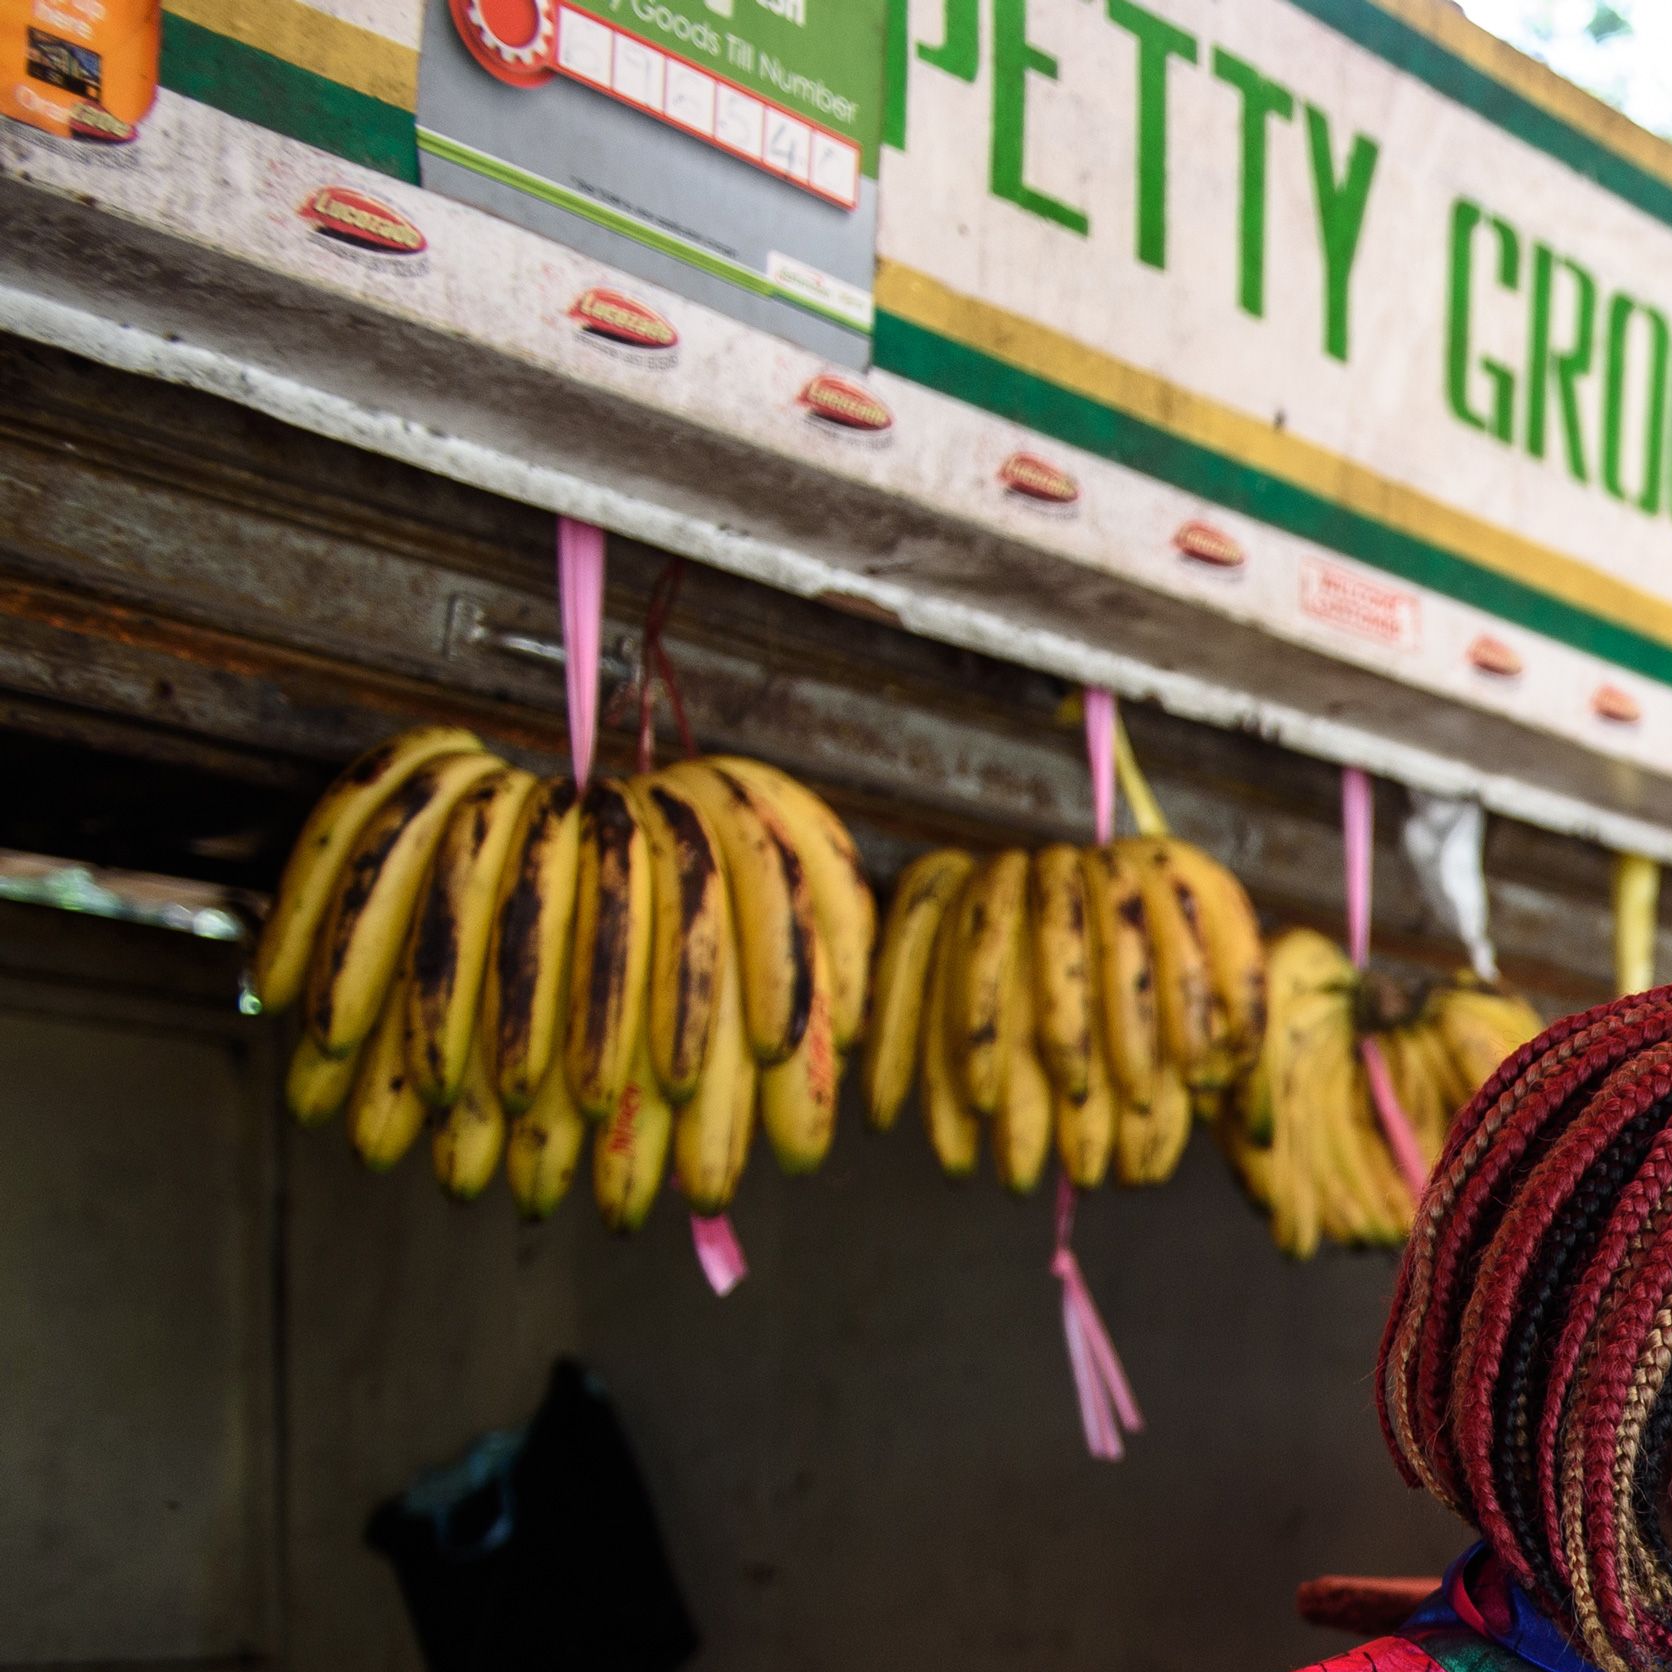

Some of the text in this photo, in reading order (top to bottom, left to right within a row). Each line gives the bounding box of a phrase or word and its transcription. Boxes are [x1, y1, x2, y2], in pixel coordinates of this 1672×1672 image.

[632, 0, 721, 56] Goods
[725, 31, 756, 72] Till
[758, 55, 860, 125] Number
[881, 0, 1380, 364] PETTY
